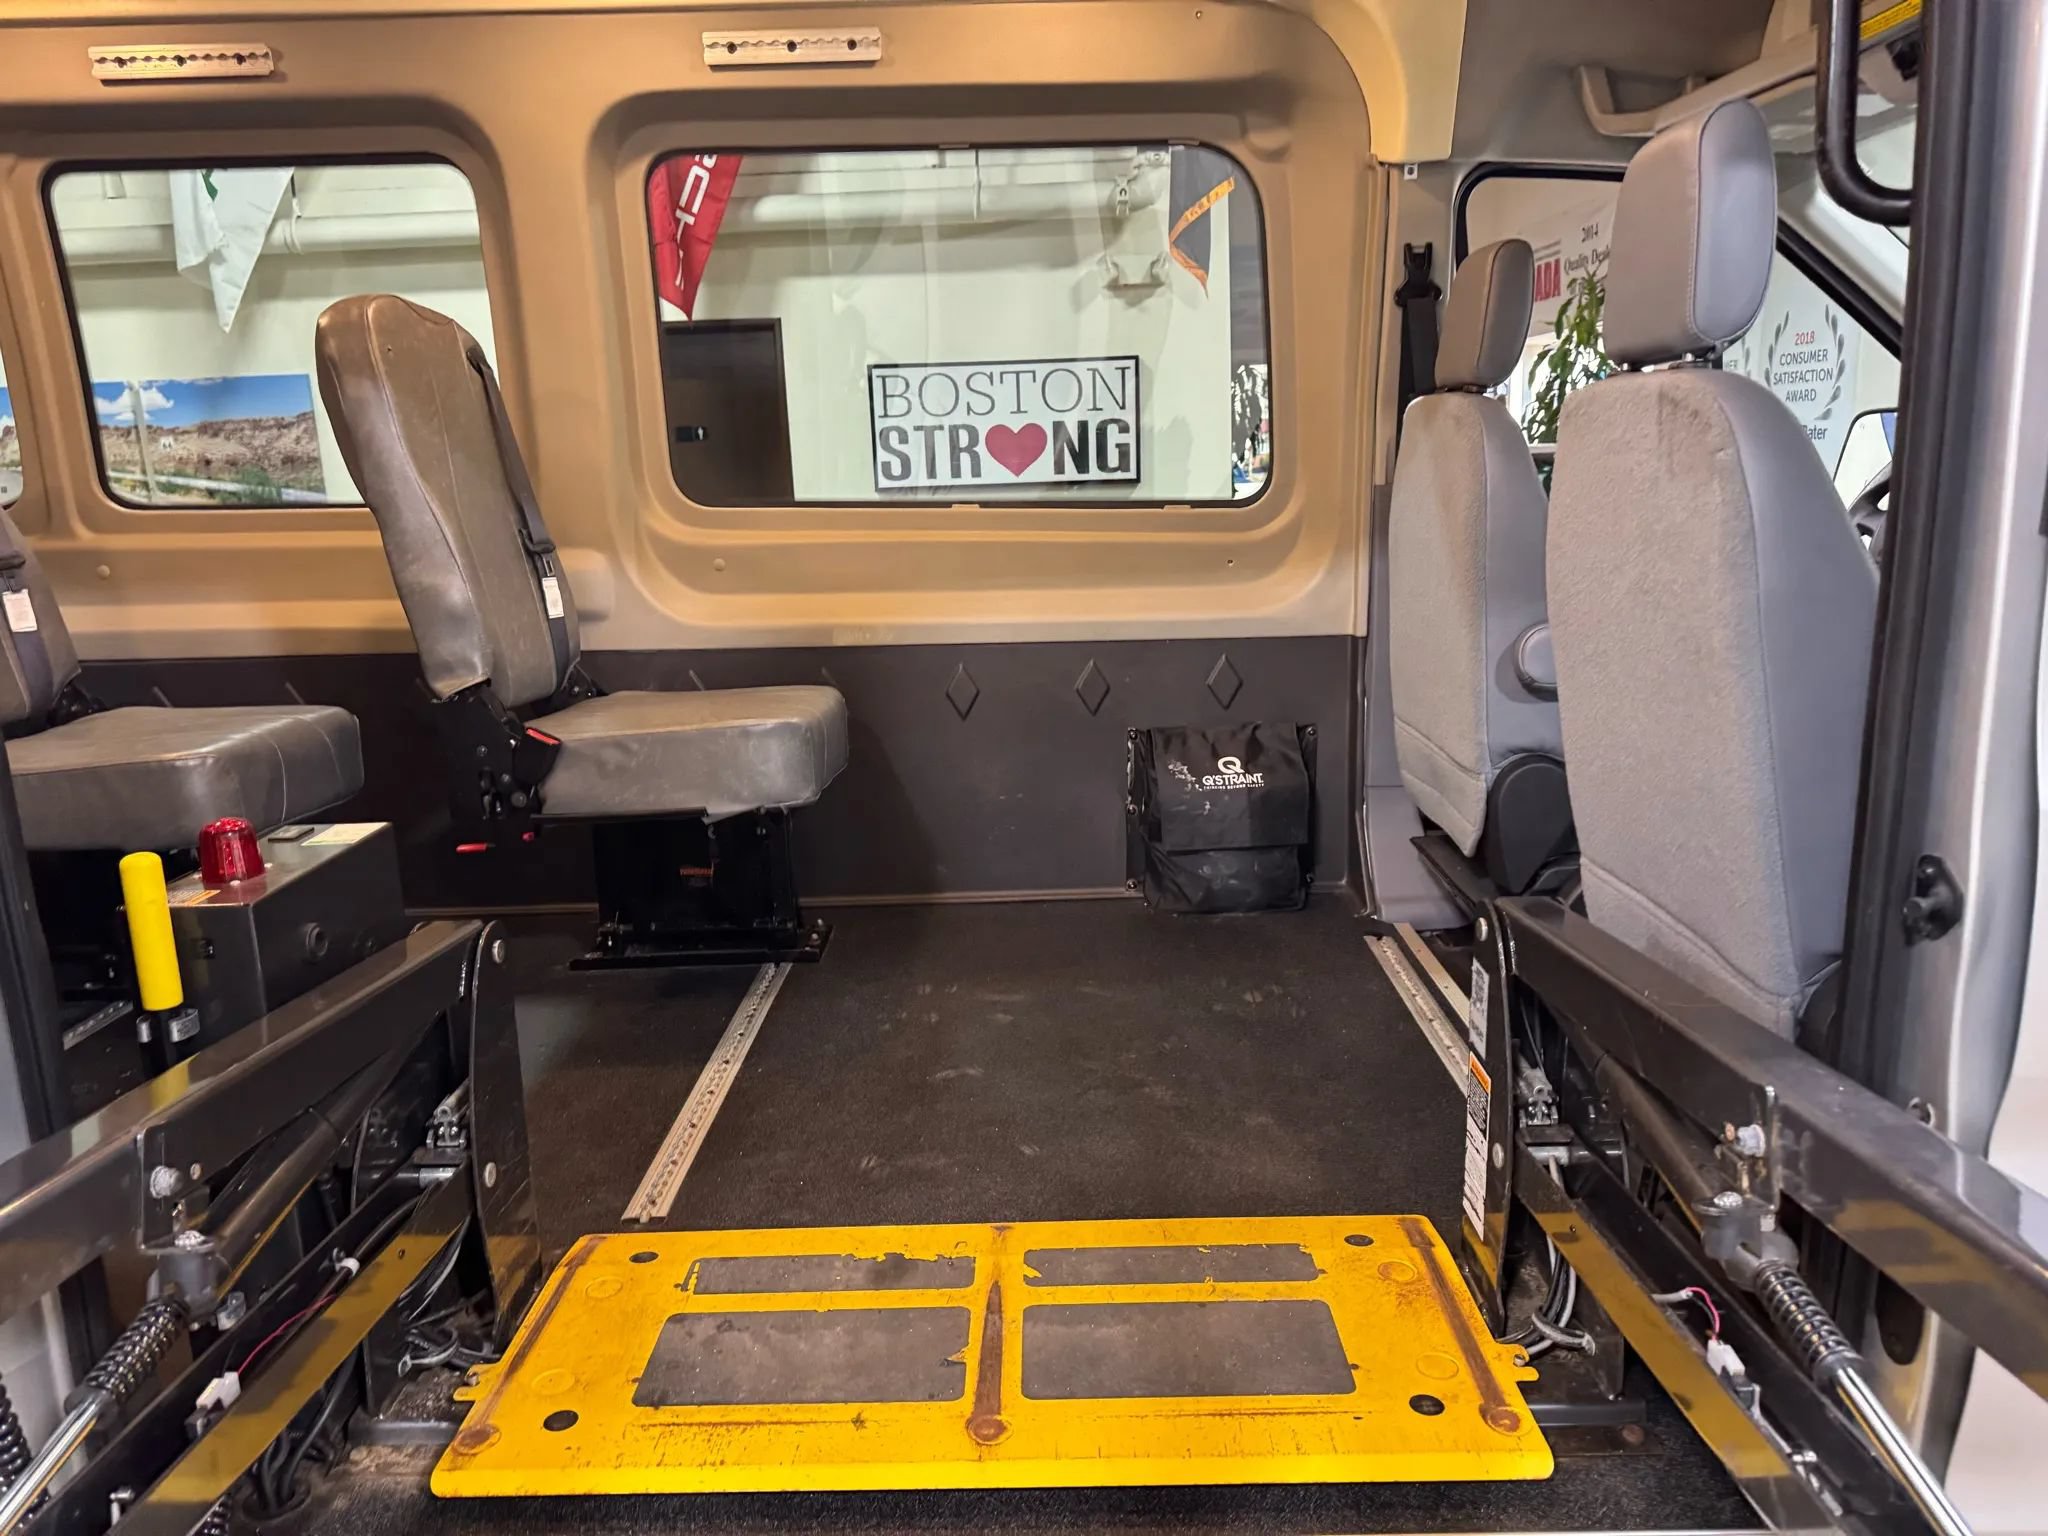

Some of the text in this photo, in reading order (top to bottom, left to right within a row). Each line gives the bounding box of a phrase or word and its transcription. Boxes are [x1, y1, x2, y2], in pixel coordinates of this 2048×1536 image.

[1794, 331, 1816, 346] 2018
[1779, 349, 1829, 367] CONSUMER
[1773, 368, 1834, 386] SATISFACTION
[876, 366, 1131, 418] BOSTON
[1785, 388, 1817, 402] AWARD
[1217, 756, 1246, 774] Q
[1202, 773, 1263, 786] Q'STRAINT
